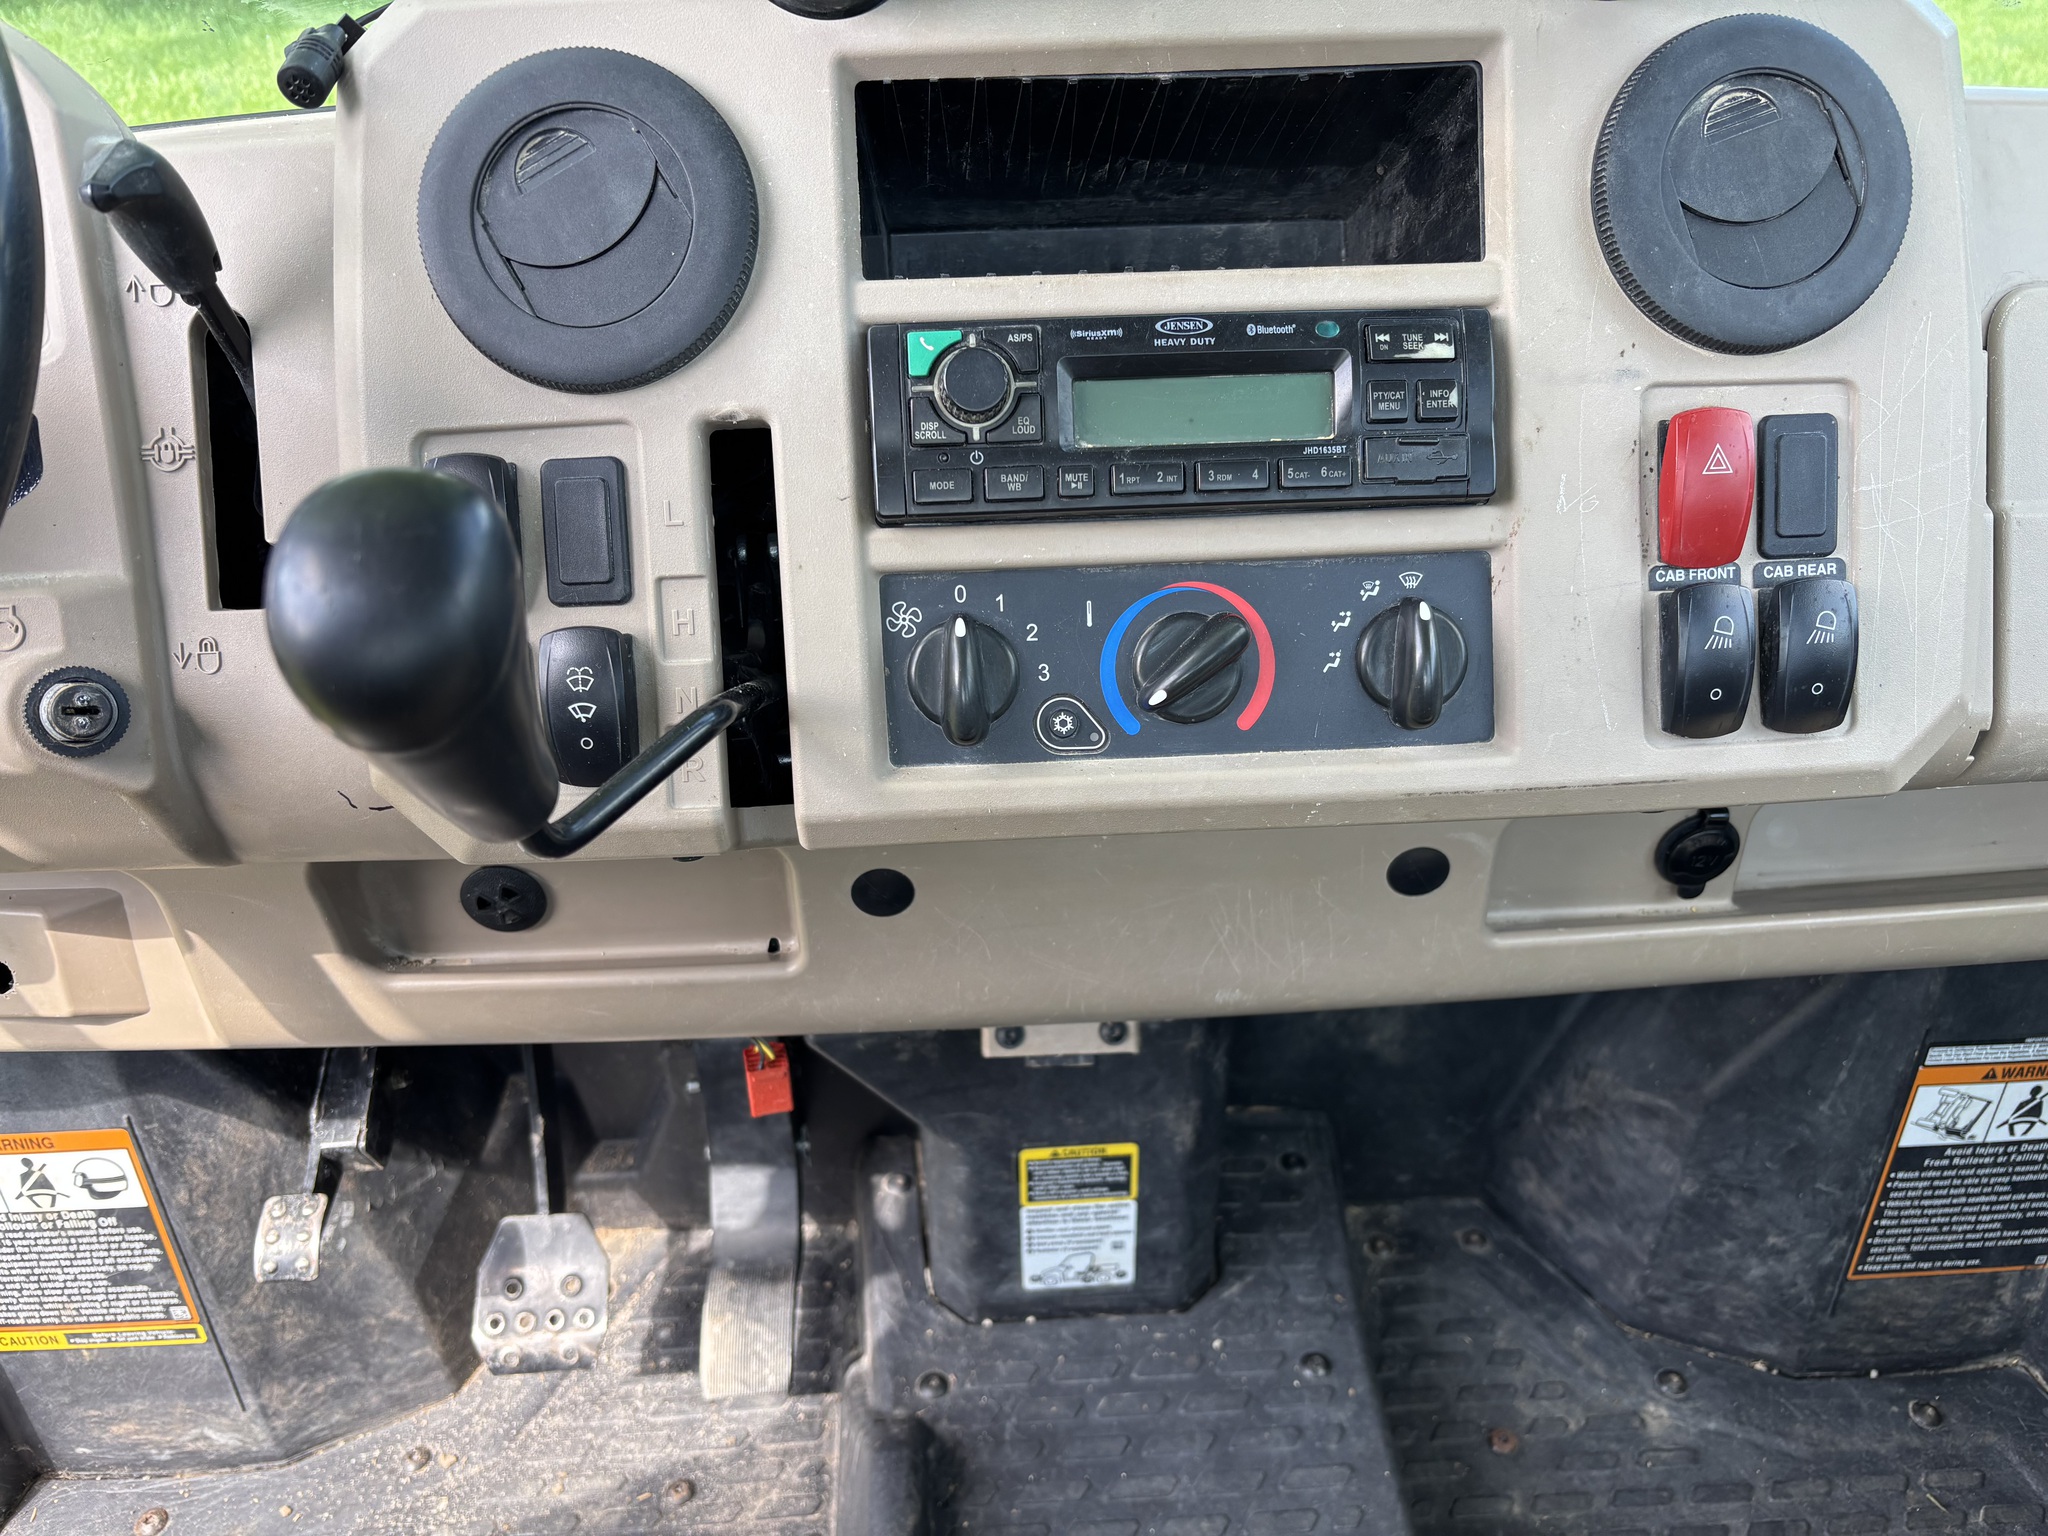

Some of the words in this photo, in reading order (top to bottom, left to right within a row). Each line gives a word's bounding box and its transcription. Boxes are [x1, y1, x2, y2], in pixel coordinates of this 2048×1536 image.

[1164, 321, 1204, 330] JENSEN
[1007, 333, 1033, 342] AS/PS
[1154, 338, 1186, 347] HEAVY
[1190, 337, 1216, 346] DUTY
[1402, 333, 1423, 342] TUNE
[1402, 341, 1424, 350] SEEK
[1373, 391, 1405, 401] PTY/CAT
[1429, 389, 1450, 398] INFO
[1378, 401, 1401, 411] MENU
[1426, 399, 1454, 409] ENTER
[920, 421, 939, 431] DISP
[1018, 416, 1030, 427] EQ
[1012, 424, 1036, 434] LOUD
[915, 429, 946, 440] SCROLL
[1302, 446, 1347, 455] JHD1635BT
[1000, 474, 1029, 483] BAND/
[1065, 473, 1089, 482] MUTE
[929, 481, 955, 490] MODE
[1007, 482, 1022, 491] WB
[663, 500, 684, 527] L
[1655, 569, 1685, 583] CAB
[1689, 567, 1736, 581] FRONT
[1763, 565, 1793, 578] CAB
[1797, 563, 1837, 576] REAR
[995, 594, 1004, 612] 1
[671, 608, 695, 636] H
[1026, 623, 1039, 642] 2
[1037, 664, 1051, 682] 3
[675, 687, 699, 714] N
[681, 758, 707, 783] R
[2000, 1065, 2048, 1079] WARN
[0, 1137, 54, 1151] RNING
[1944, 1147, 1973, 1157] Avoid
[1975, 1144, 2005, 1156] Injury
[2007, 1145, 2018, 1153] or
[2020, 1142, 2048, 1151] Death
[1924, 1158, 1950, 1167] From
[1952, 1156, 1994, 1166] Rollover
[1997, 1155, 2006, 1163] or
[2010, 1153, 2045, 1162] Falling
[0, 1222, 38, 1230] ollover
[0, 1335, 59, 1347] CAUTION
